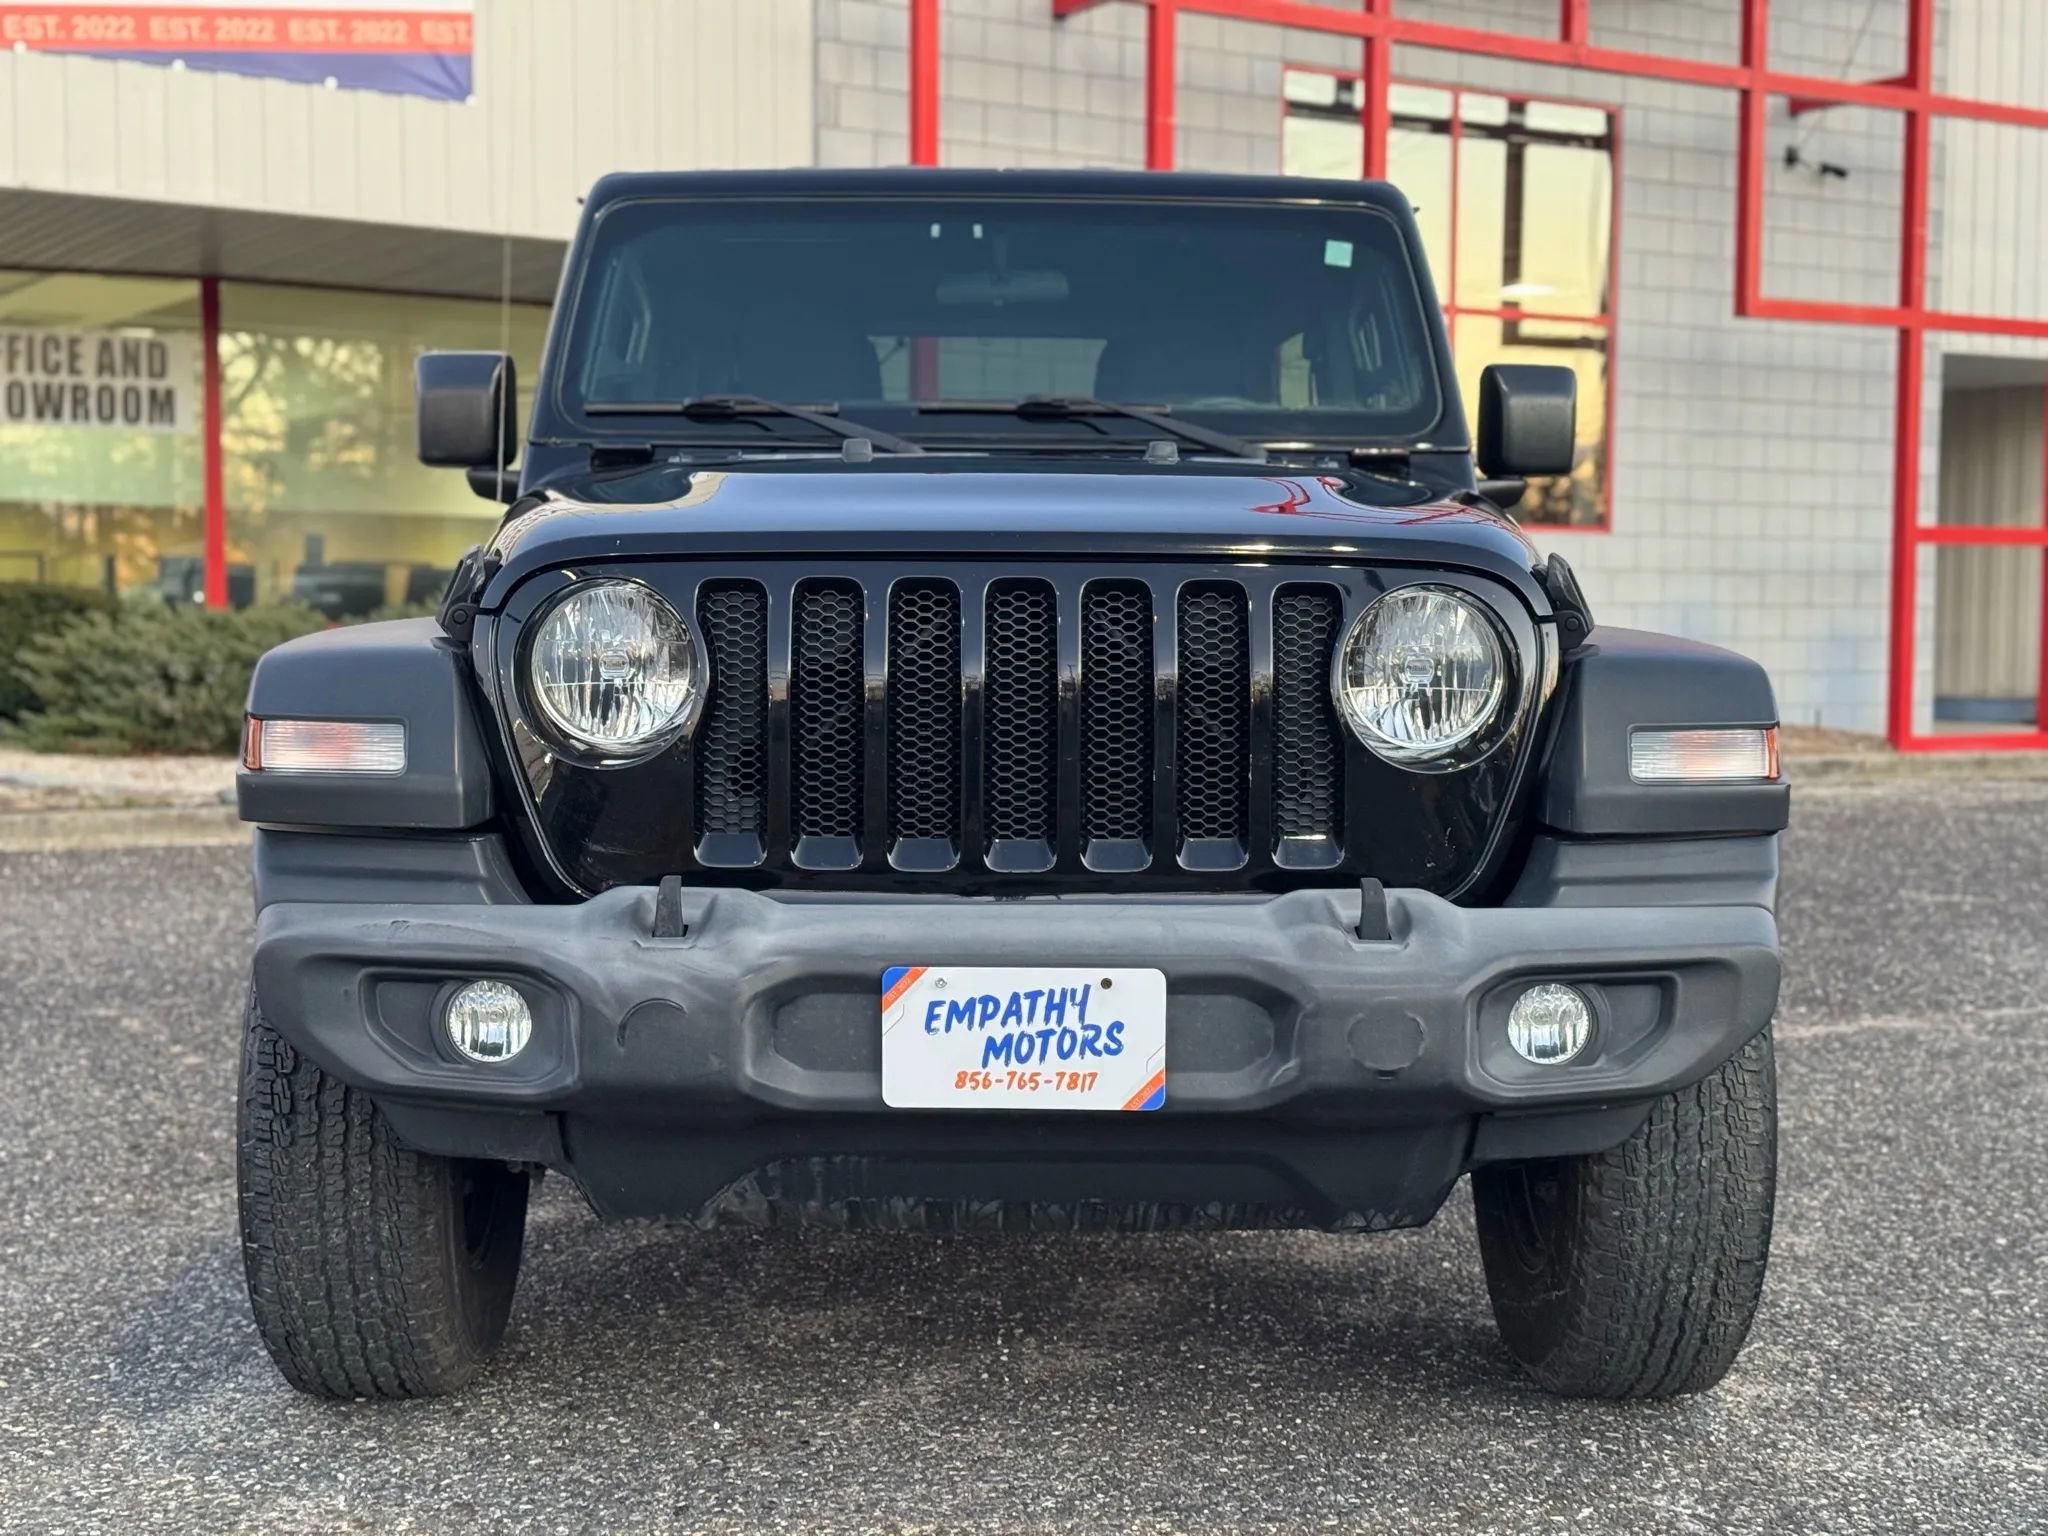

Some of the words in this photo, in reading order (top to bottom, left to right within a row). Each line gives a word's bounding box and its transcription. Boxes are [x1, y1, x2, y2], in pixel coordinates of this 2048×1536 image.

[70, 14, 137, 41] 2022
[213, 16, 277, 42] 2022
[0, 335, 83, 376] FICE
[97, 336, 168, 379] AND
[6, 380, 176, 425] OWROOM
[924, 983, 1092, 1036] EMPATHY
[981, 1020, 1126, 1070] MOTORS
[954, 1070, 1098, 1093] 856-765-7817
